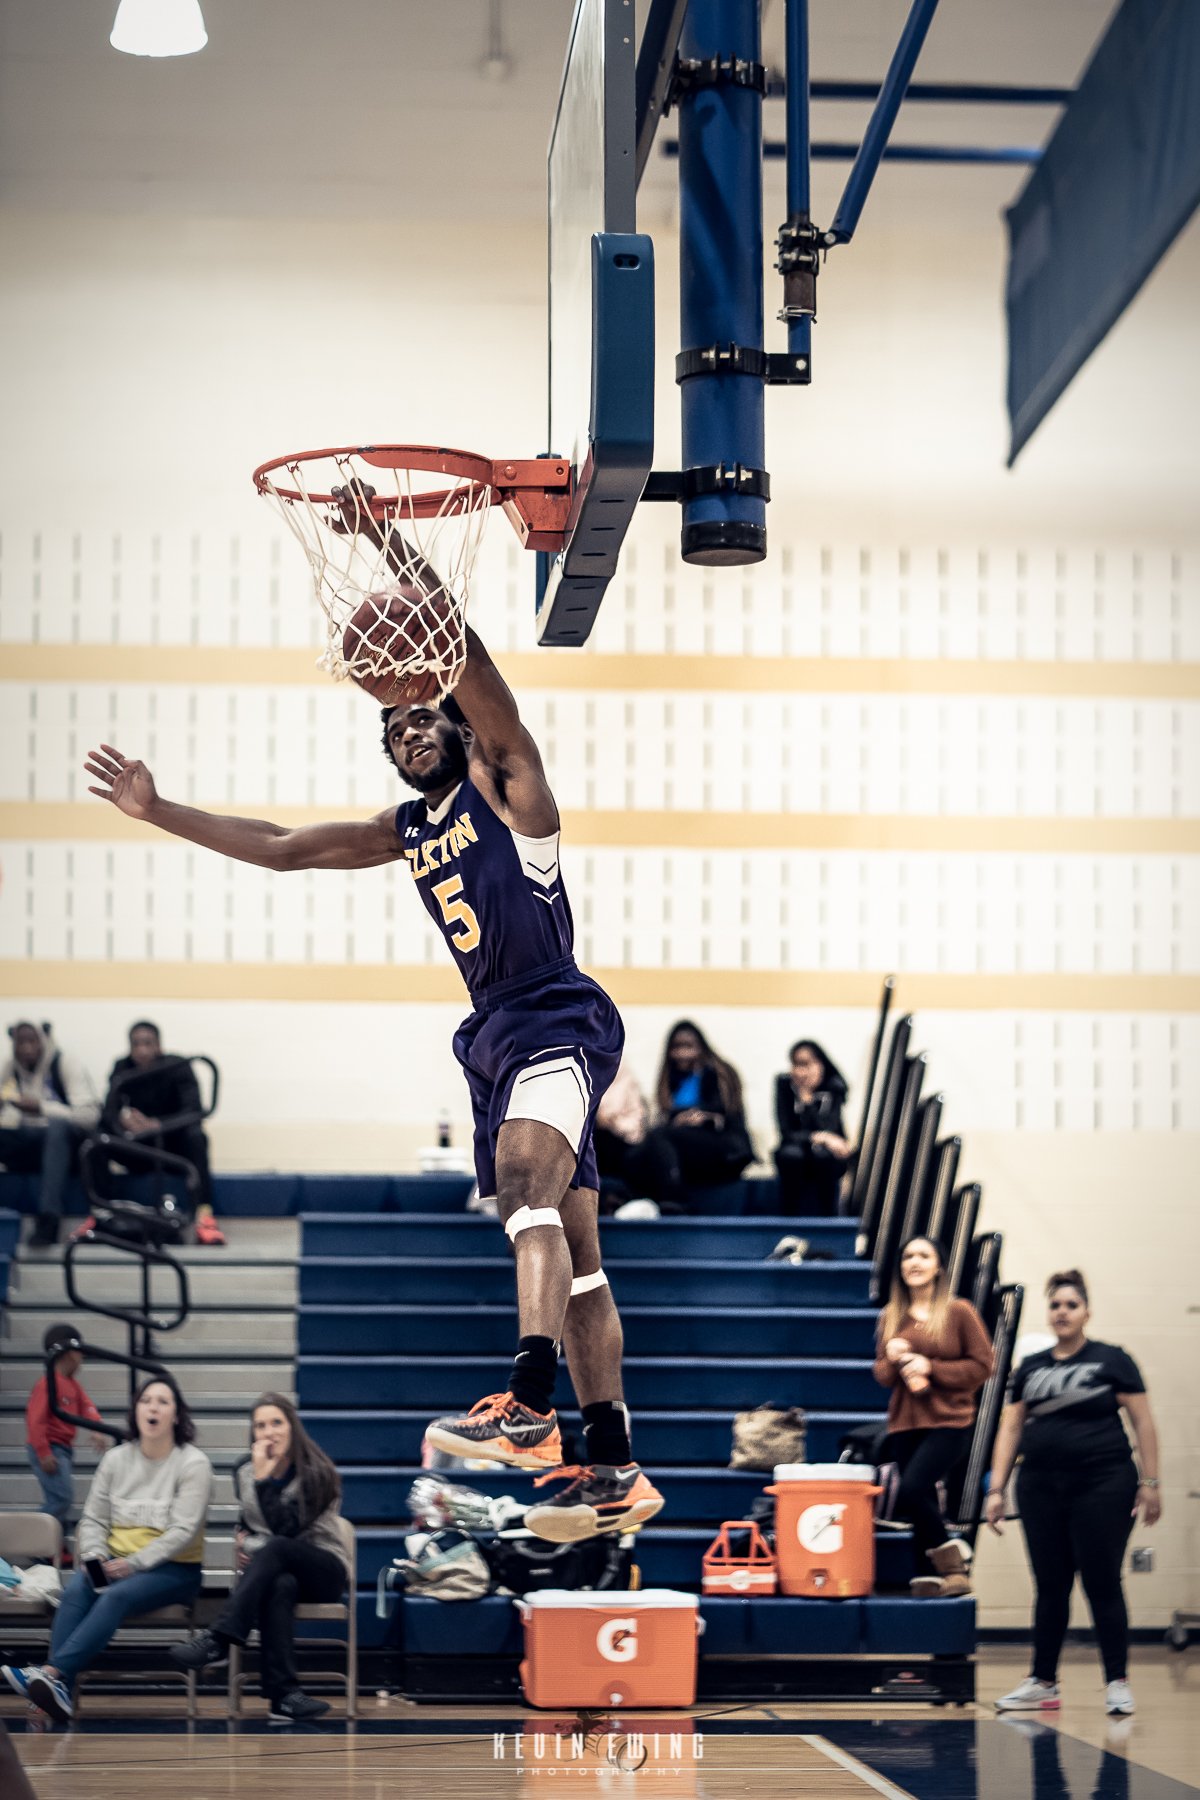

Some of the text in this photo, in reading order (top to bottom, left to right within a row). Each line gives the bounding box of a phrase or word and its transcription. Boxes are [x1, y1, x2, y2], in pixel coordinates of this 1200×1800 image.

[431, 873, 481, 953] 5
[797, 1503, 848, 1554] G
[596, 1618, 638, 1662] G
